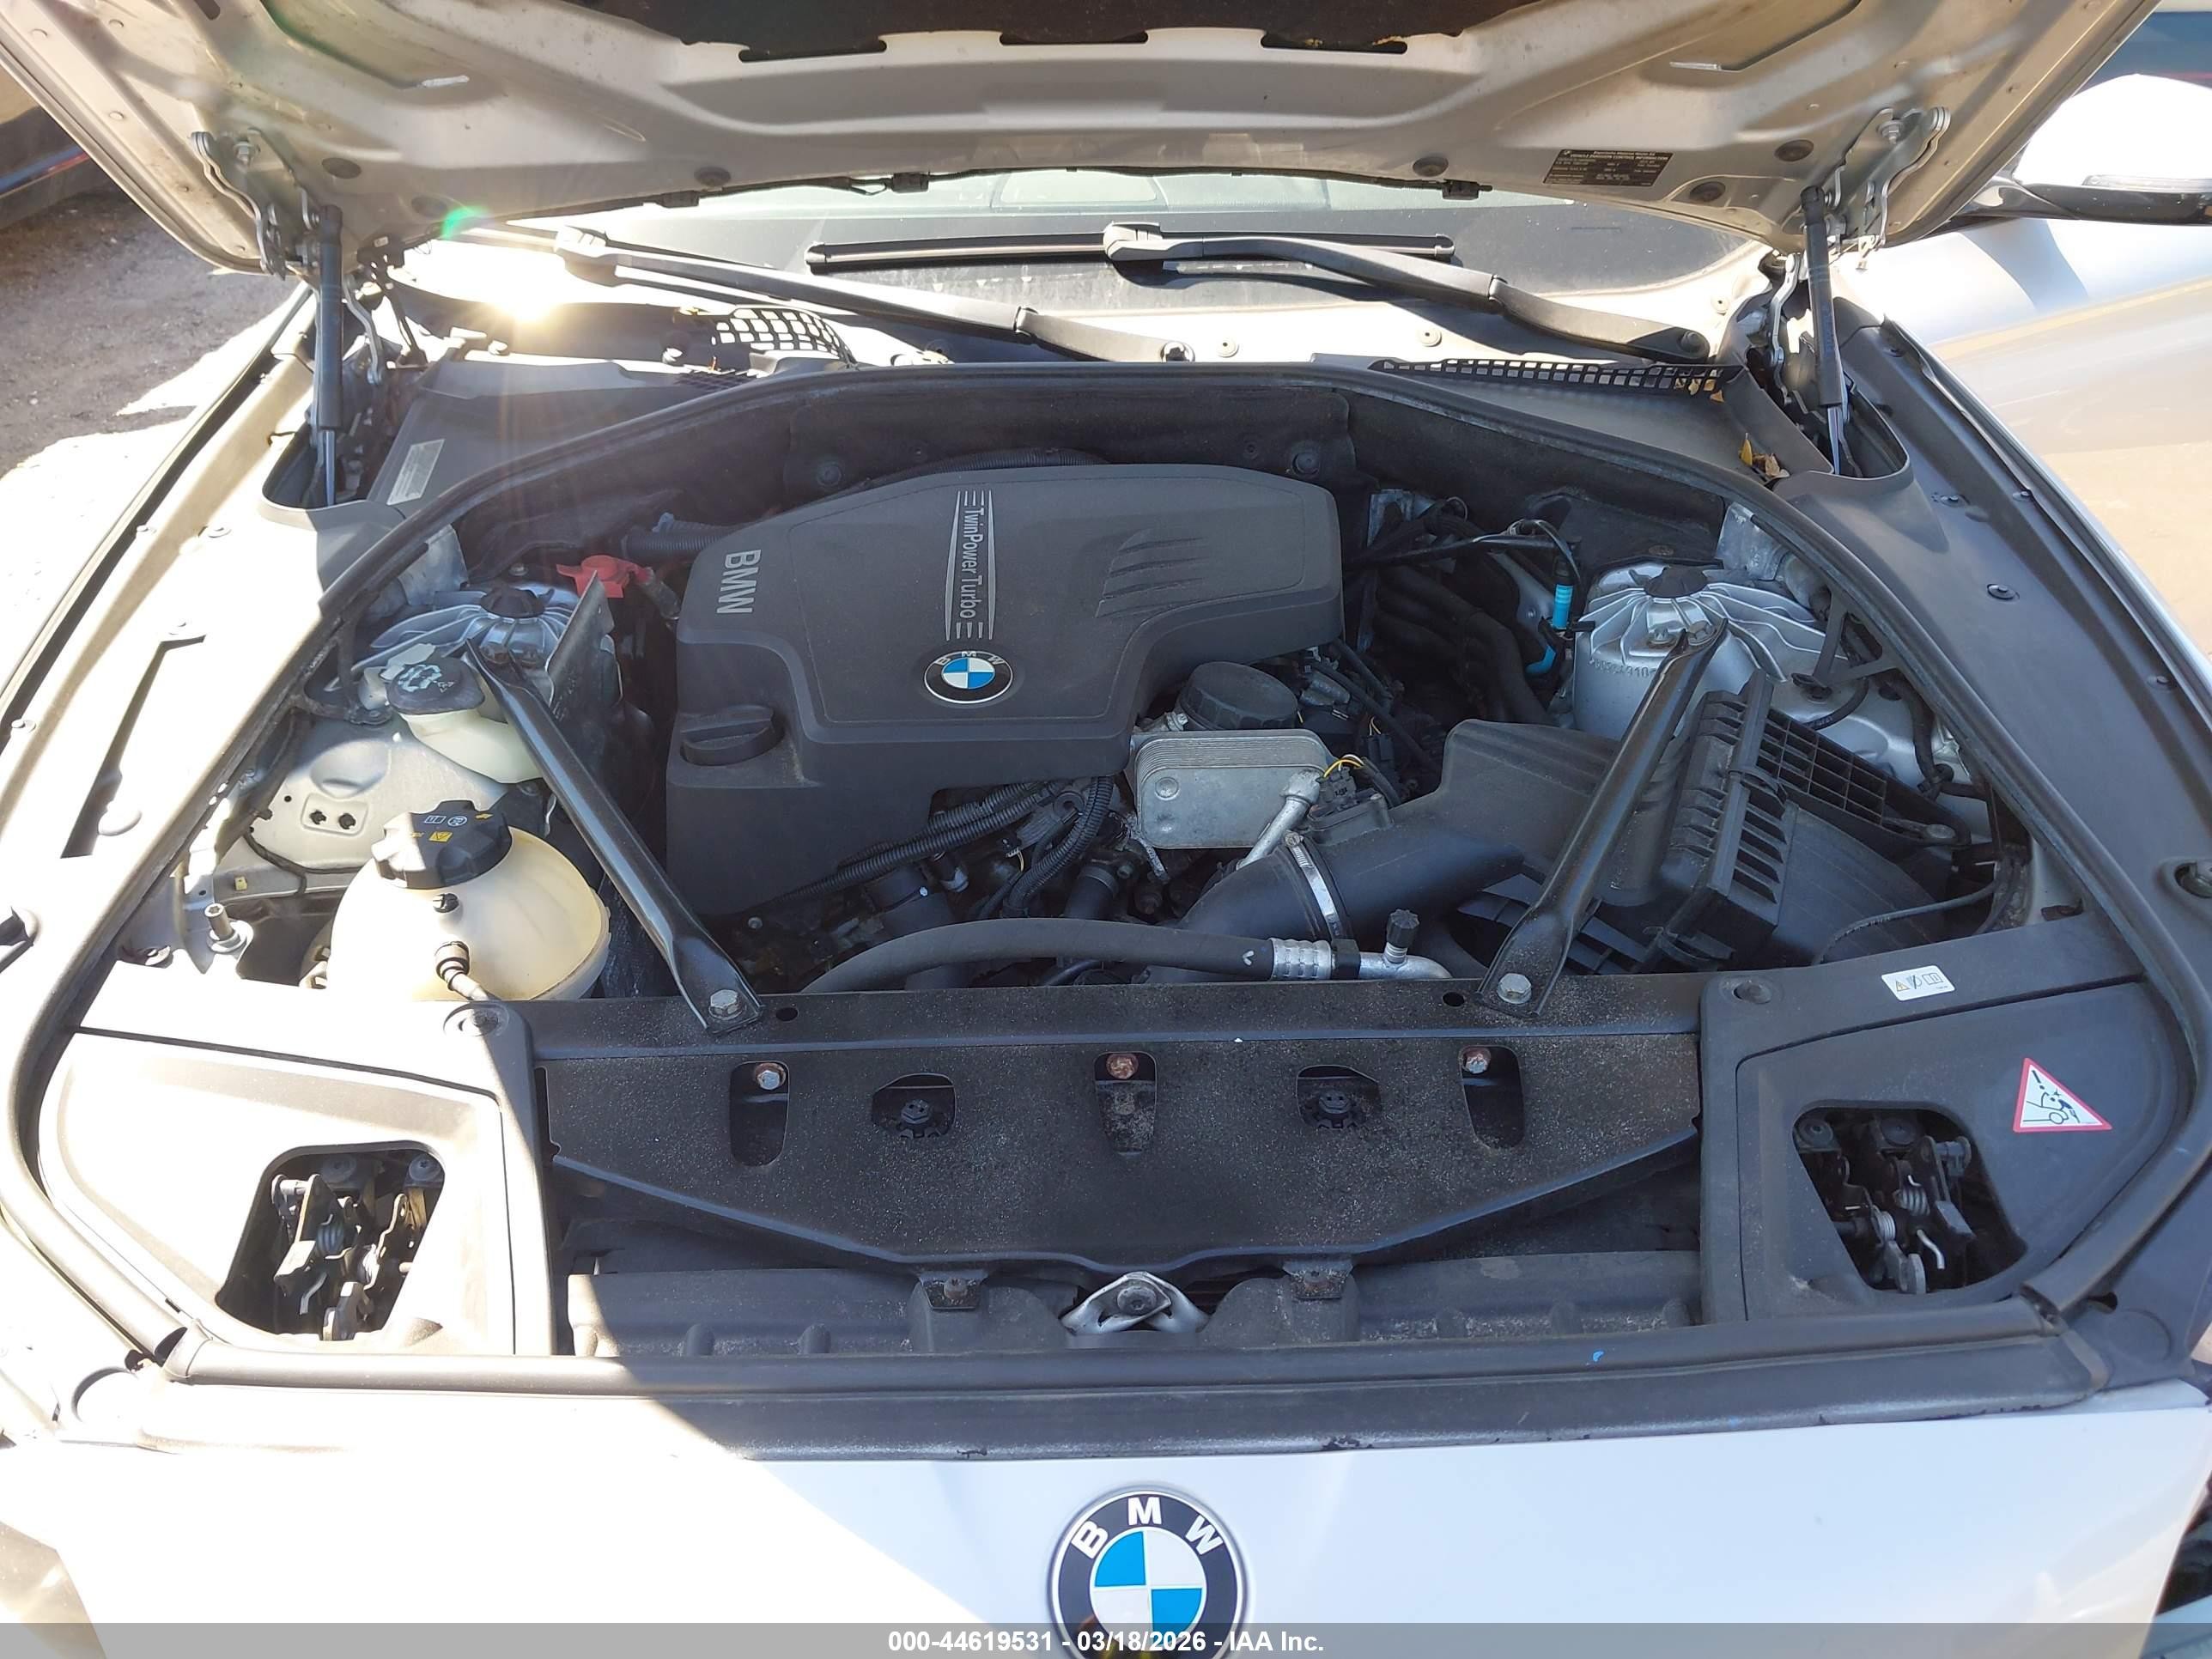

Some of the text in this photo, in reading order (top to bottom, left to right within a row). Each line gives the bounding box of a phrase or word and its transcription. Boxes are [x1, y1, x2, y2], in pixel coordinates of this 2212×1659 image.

[716, 549, 762, 614] BMW
[959, 507, 985, 619] TwinPower Turbo
[934, 650, 1006, 665] BMW
[1071, 1496, 1224, 1559] BMW
